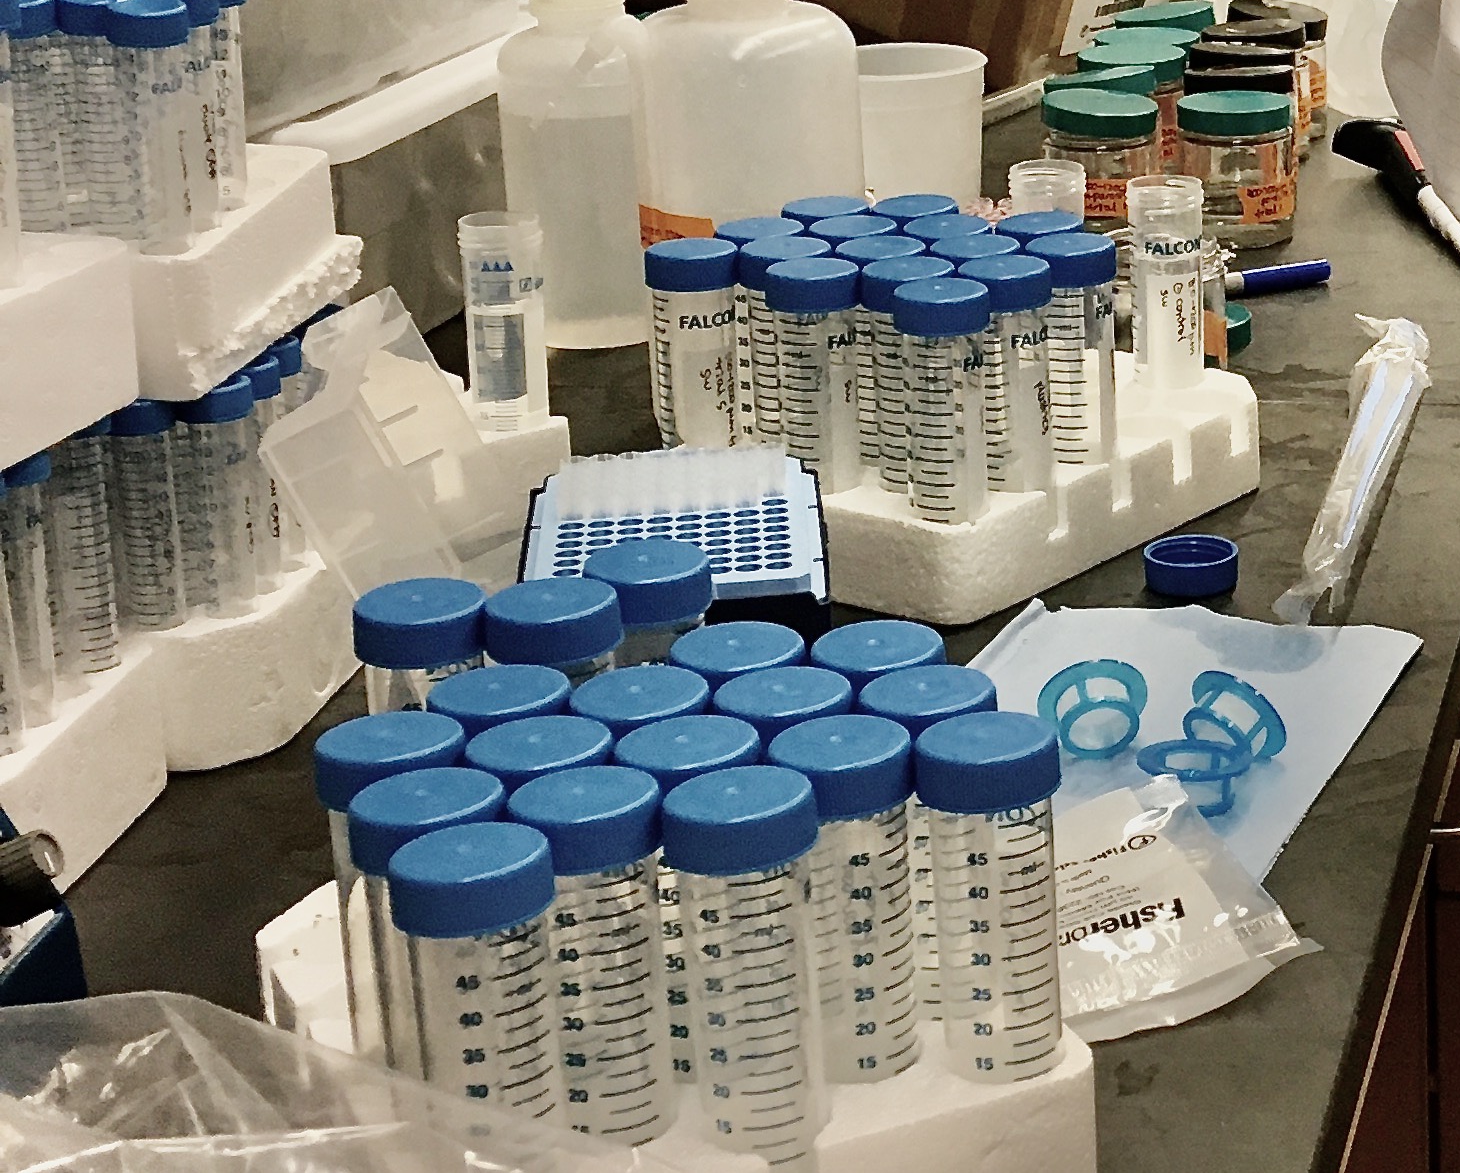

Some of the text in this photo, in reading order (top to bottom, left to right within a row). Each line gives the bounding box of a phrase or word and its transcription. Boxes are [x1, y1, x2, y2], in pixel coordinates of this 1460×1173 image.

[850, 853, 870, 866] 45
[967, 853, 988, 866] 45
[851, 886, 872, 899] 40
[968, 886, 989, 899] 40
[969, 920, 990, 933] 35
[971, 953, 992, 966] 30
[855, 988, 875, 1001] 25
[972, 987, 992, 1001] 25
[855, 1022, 876, 1035] 20
[973, 1023, 993, 1035] 20
[857, 1057, 877, 1070] 15
[975, 1057, 994, 1070] 15
